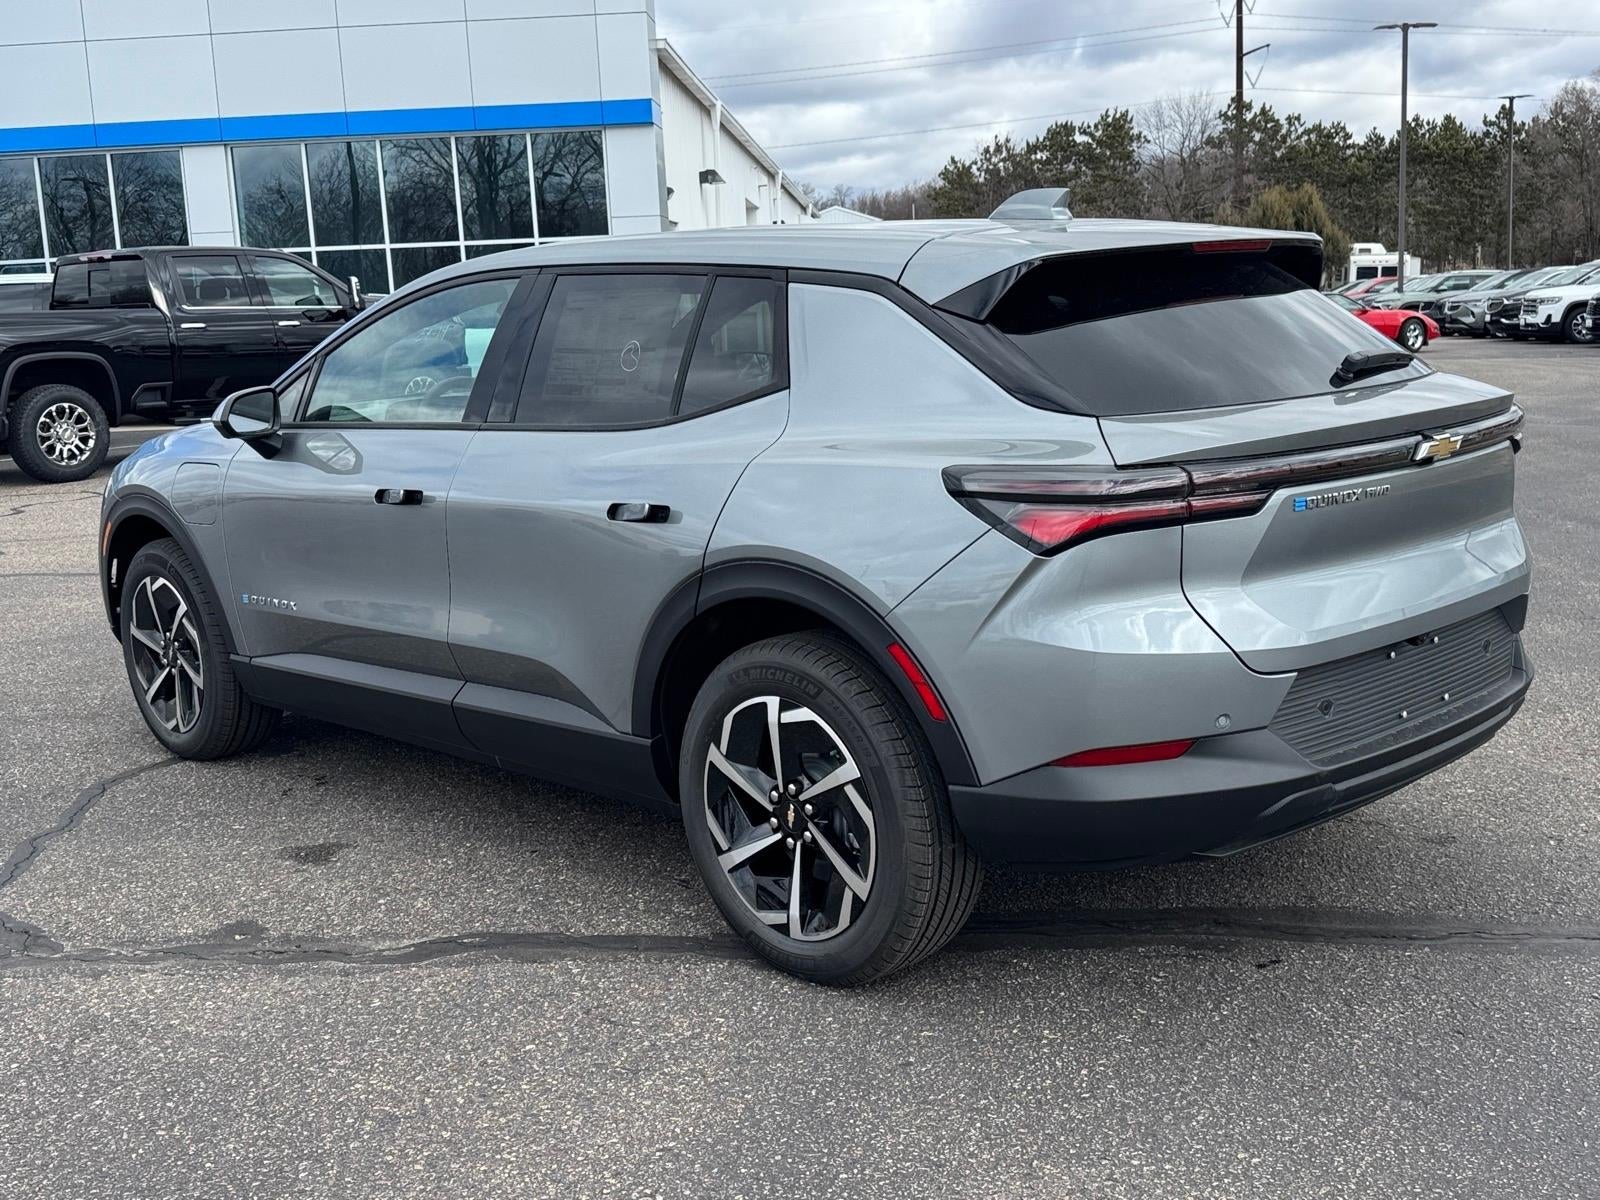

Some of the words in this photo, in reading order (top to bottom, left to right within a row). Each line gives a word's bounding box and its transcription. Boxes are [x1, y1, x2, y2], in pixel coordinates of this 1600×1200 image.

[1294, 488, 1362, 511] EQUINOX
[1365, 484, 1391, 499] AWD
[241, 594, 297, 611] EQUINOX
[749, 668, 819, 697] MICHELIN
